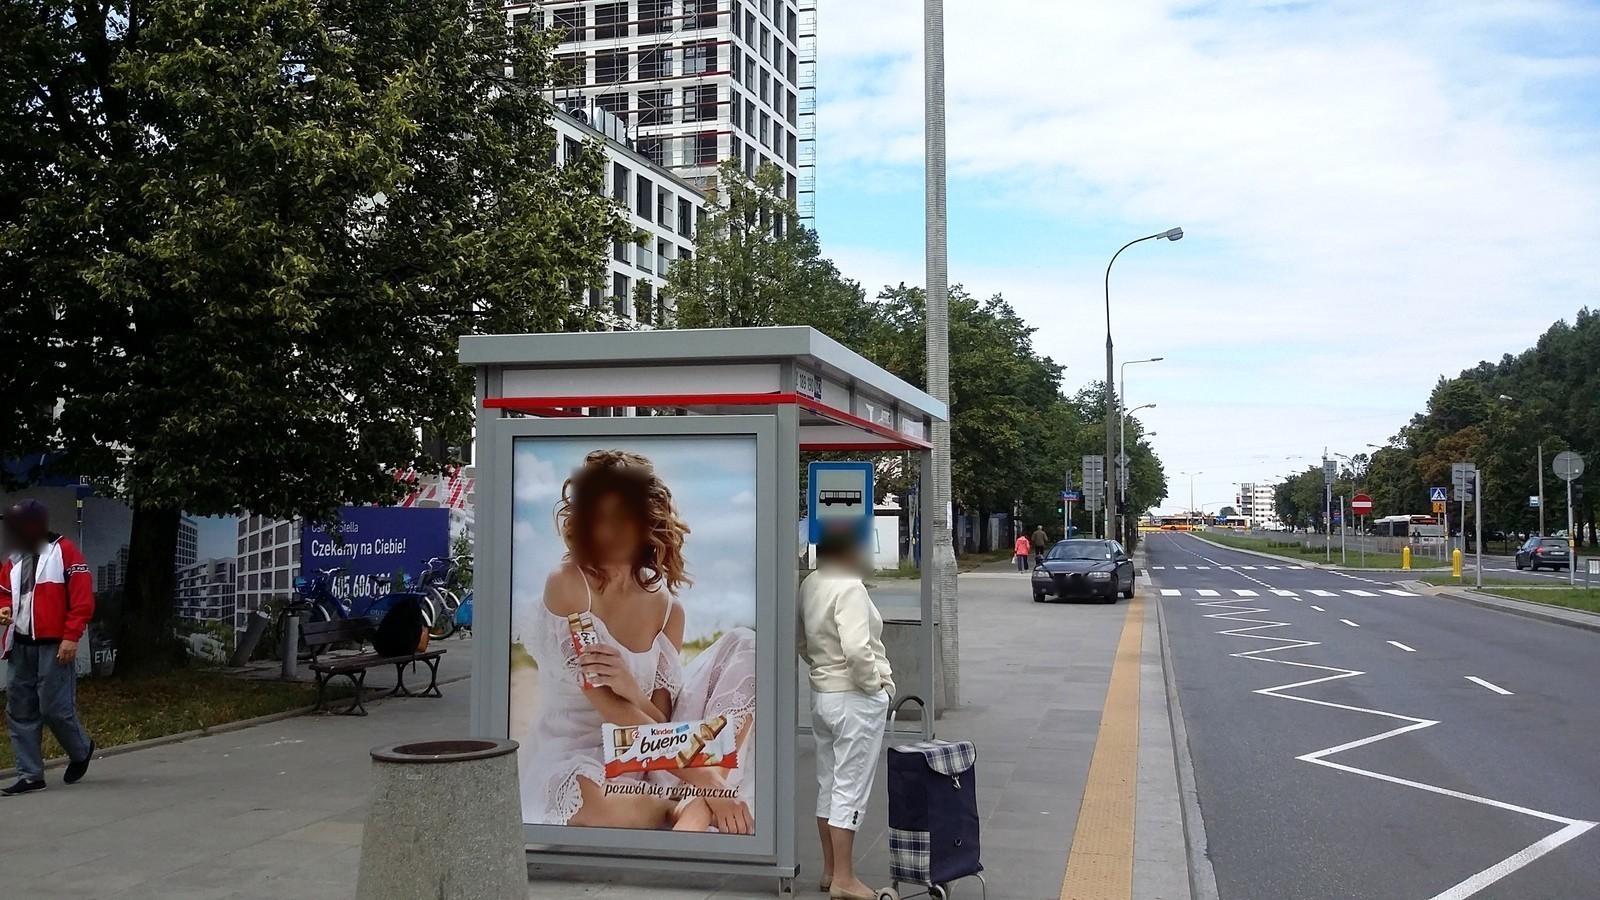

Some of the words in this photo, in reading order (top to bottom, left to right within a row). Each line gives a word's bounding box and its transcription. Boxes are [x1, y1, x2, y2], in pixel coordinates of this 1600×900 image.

[311, 540, 358, 559] Czekamy
[360, 543, 373, 555] na
[374, 538, 406, 555] Ciebie!
[331, 575, 351, 599] 605
[353, 573, 371, 598] 606
[640, 733, 688, 754] bueno
[604, 781, 645, 797] pozwól
[646, 783, 664, 798] się
[665, 783, 739, 800] rozpieszczać
